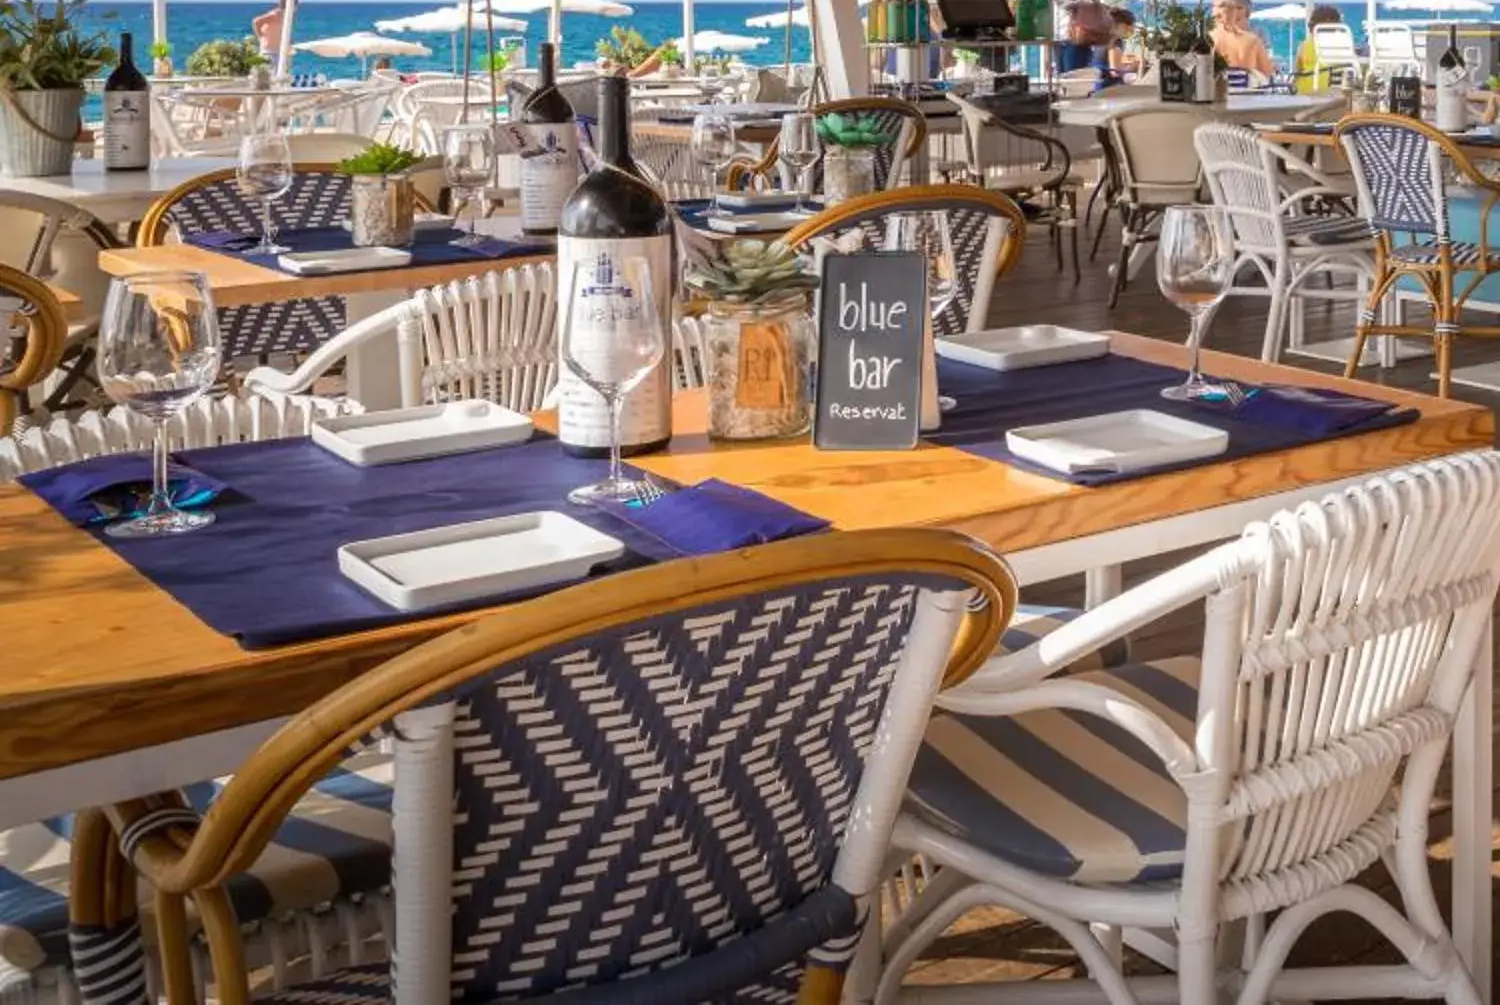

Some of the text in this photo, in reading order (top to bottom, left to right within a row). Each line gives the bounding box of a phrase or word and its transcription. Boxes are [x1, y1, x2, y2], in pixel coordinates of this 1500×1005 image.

[839, 282, 907, 332] blue
[849, 338, 902, 390] bar
[829, 402, 907, 420] Reservat
